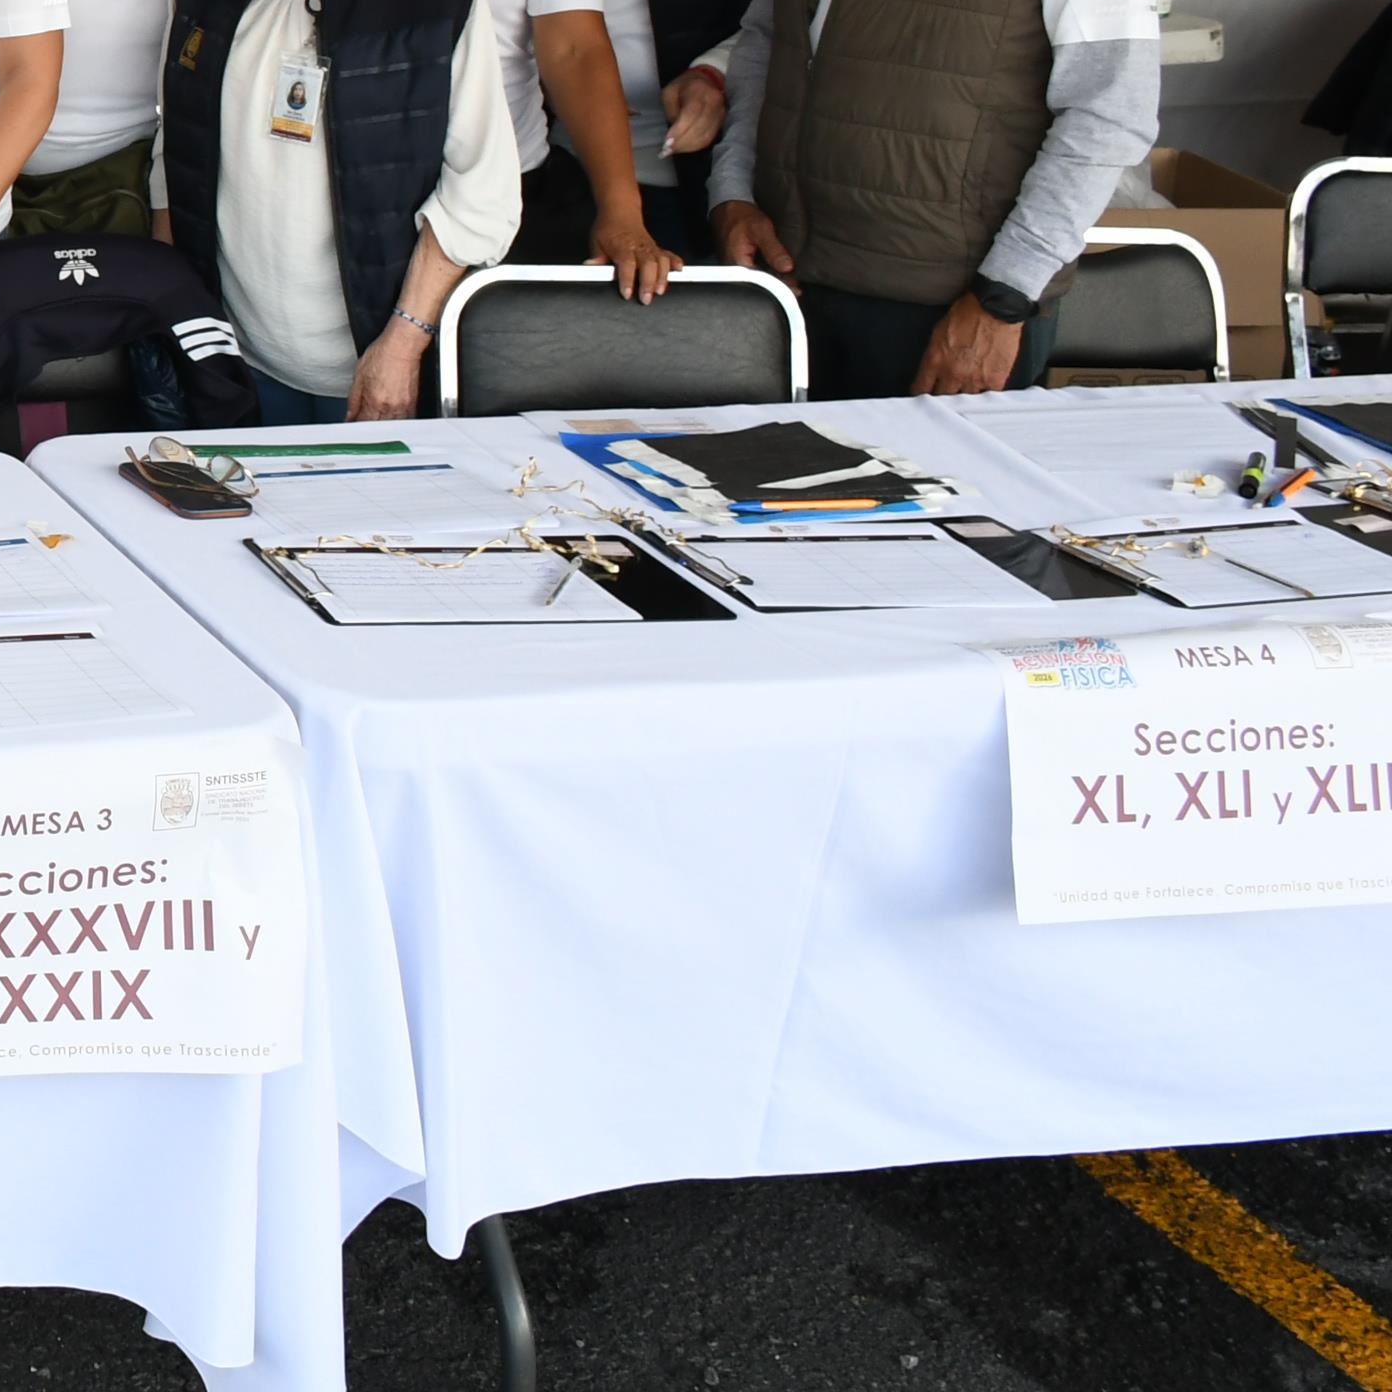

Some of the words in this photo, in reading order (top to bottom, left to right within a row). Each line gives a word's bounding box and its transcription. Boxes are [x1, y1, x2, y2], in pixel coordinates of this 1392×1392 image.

[54, 247, 98, 261] adidas
[1175, 645, 1252, 669] MESA
[1261, 644, 1276, 666] 4
[1134, 719, 1336, 756] Secciones:
[205, 770, 267, 786] SNTISSSTE
[1071, 775, 1152, 829] XL,
[1175, 769, 1252, 820] XLI
[1273, 792, 1292, 825] y
[0, 810, 86, 836] MESA
[96, 808, 113, 830] 3
[1114, 890, 1139, 903] que
[1224, 879, 1310, 896] Compromiso
[1316, 879, 1343, 891] que
[239, 923, 262, 961] y
[29, 1043, 134, 1058] Compromiso
[141, 1043, 172, 1057] que
